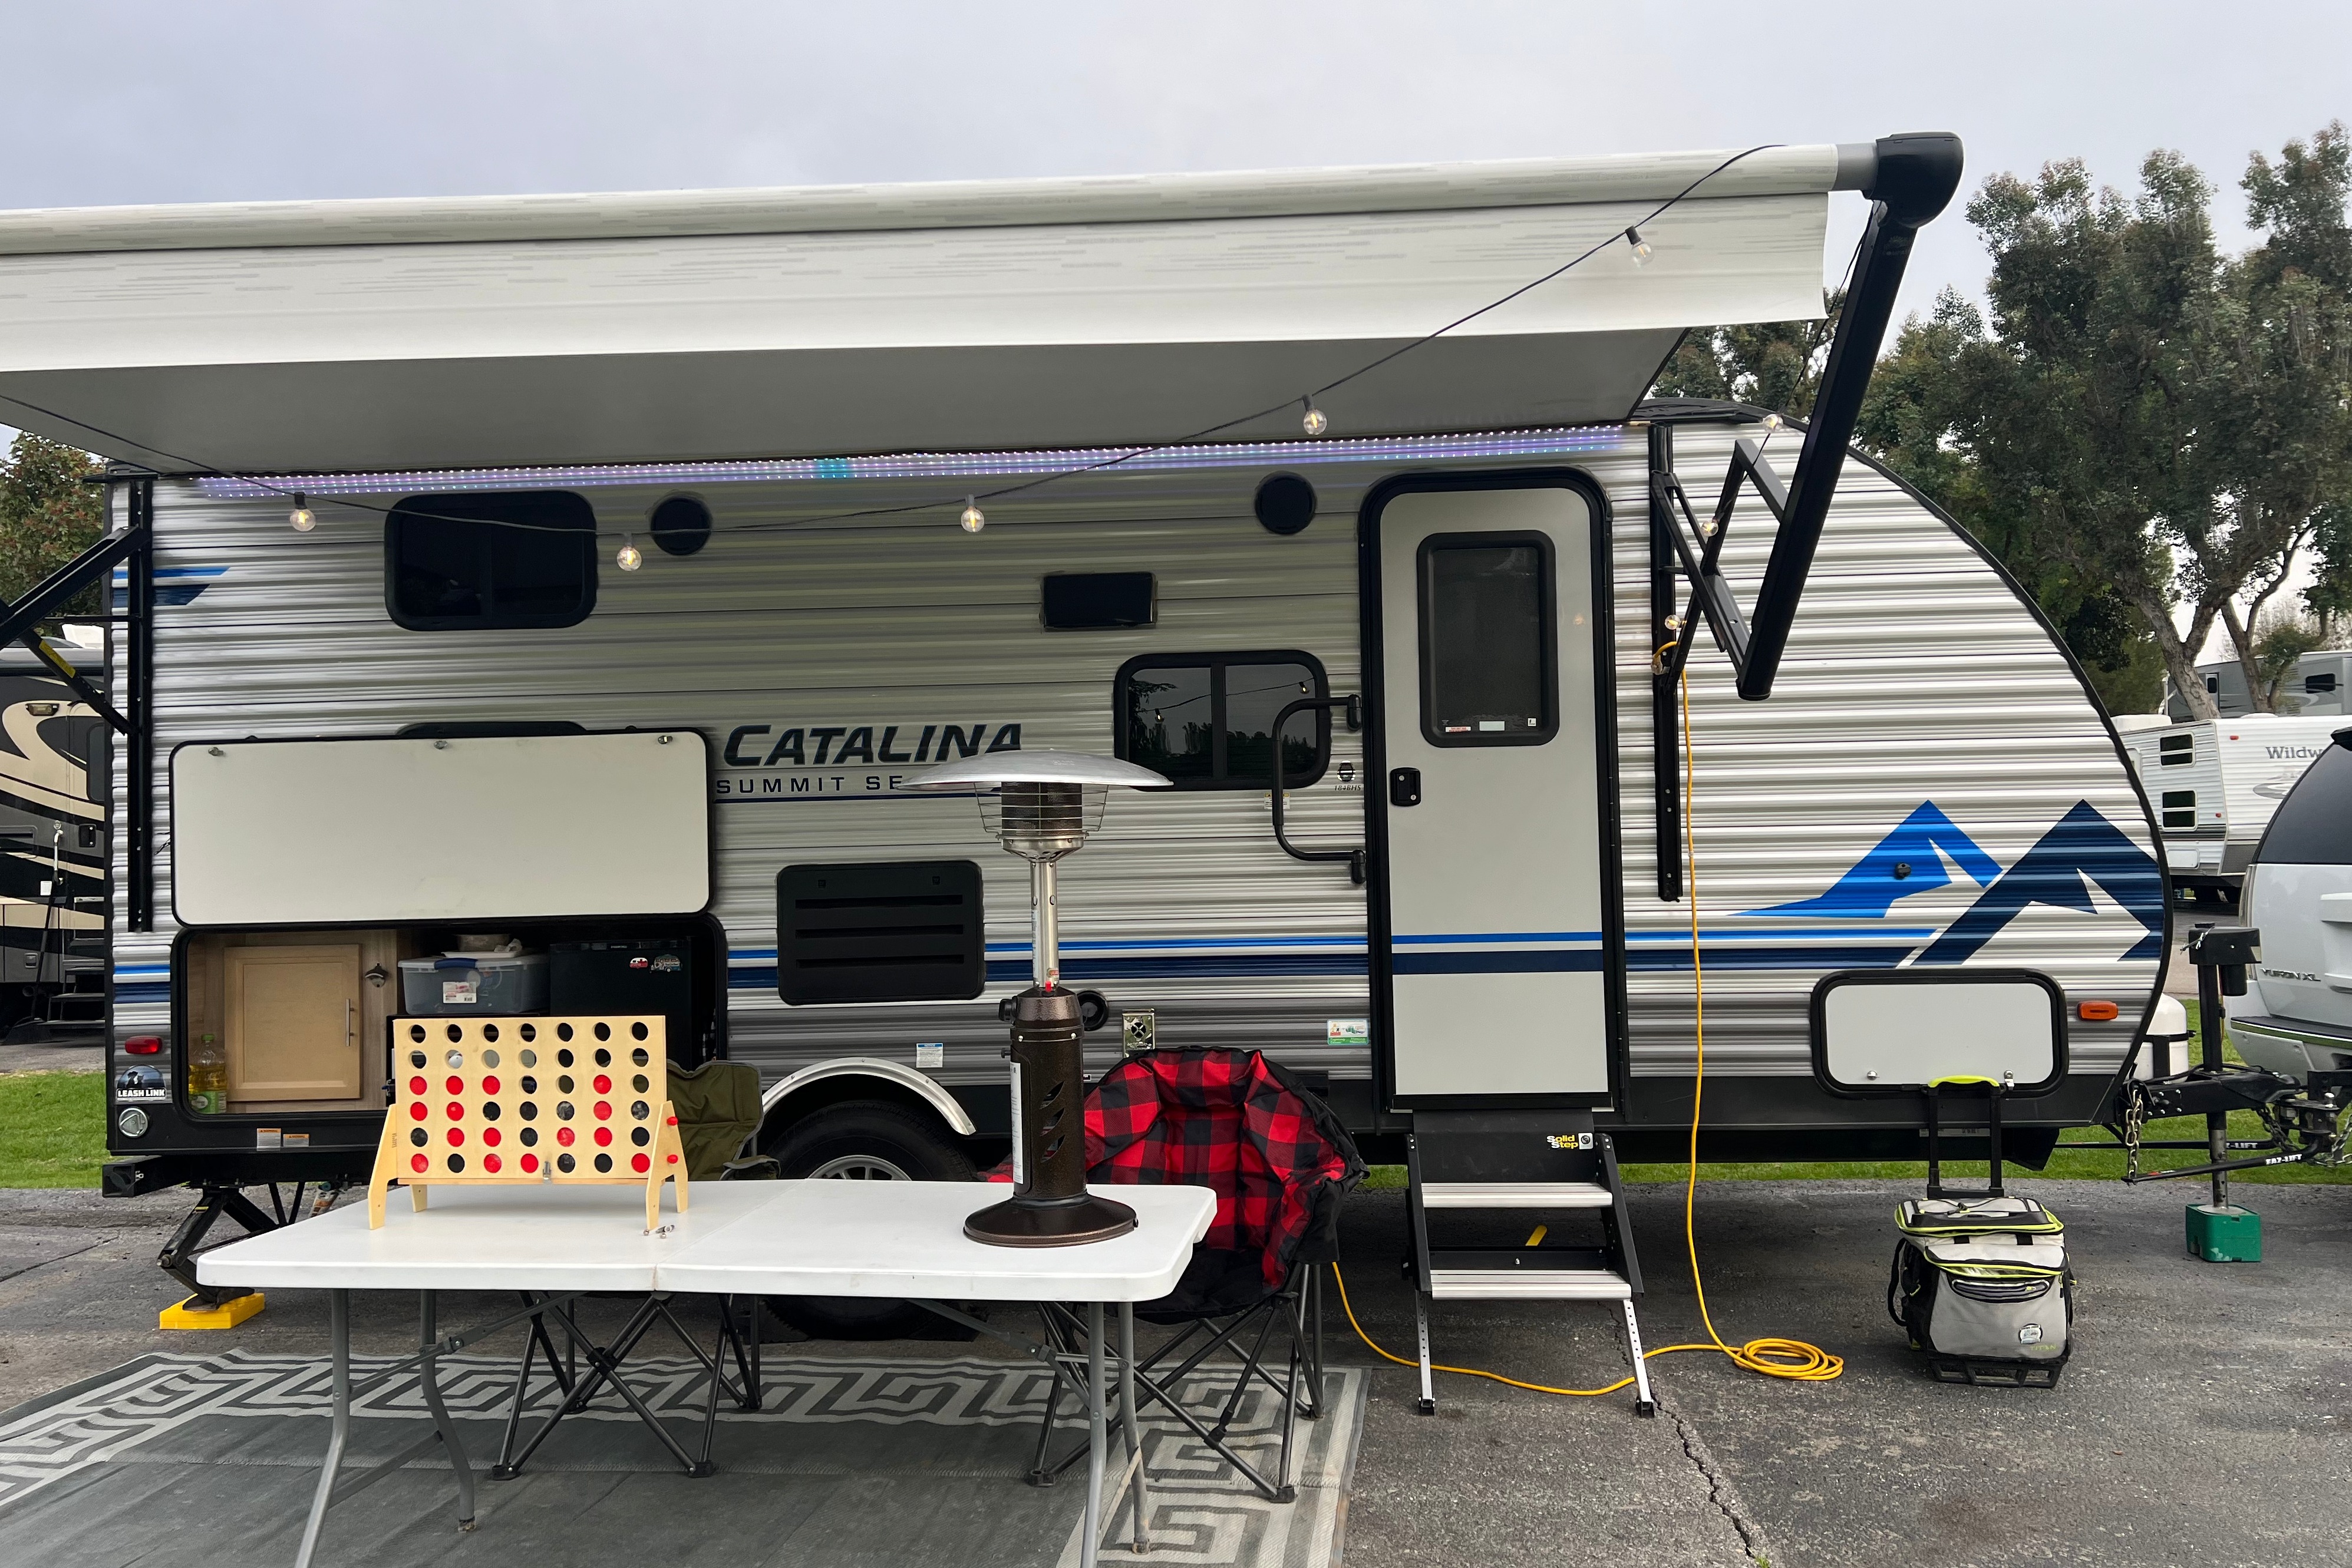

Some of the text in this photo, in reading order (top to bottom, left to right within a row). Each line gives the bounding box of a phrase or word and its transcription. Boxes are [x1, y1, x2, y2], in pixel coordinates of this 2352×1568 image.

[723, 723, 1022, 766] CATALINA
[2265, 746, 2323, 759] Wildw
[716, 777, 845, 794] SUMMIT
[2301, 972, 2321, 982] XL
[1546, 1134, 1575, 1143] Solid
[1551, 1141, 1579, 1149] Step
[2265, 1154, 2302, 1166] EAZ-LIFT
